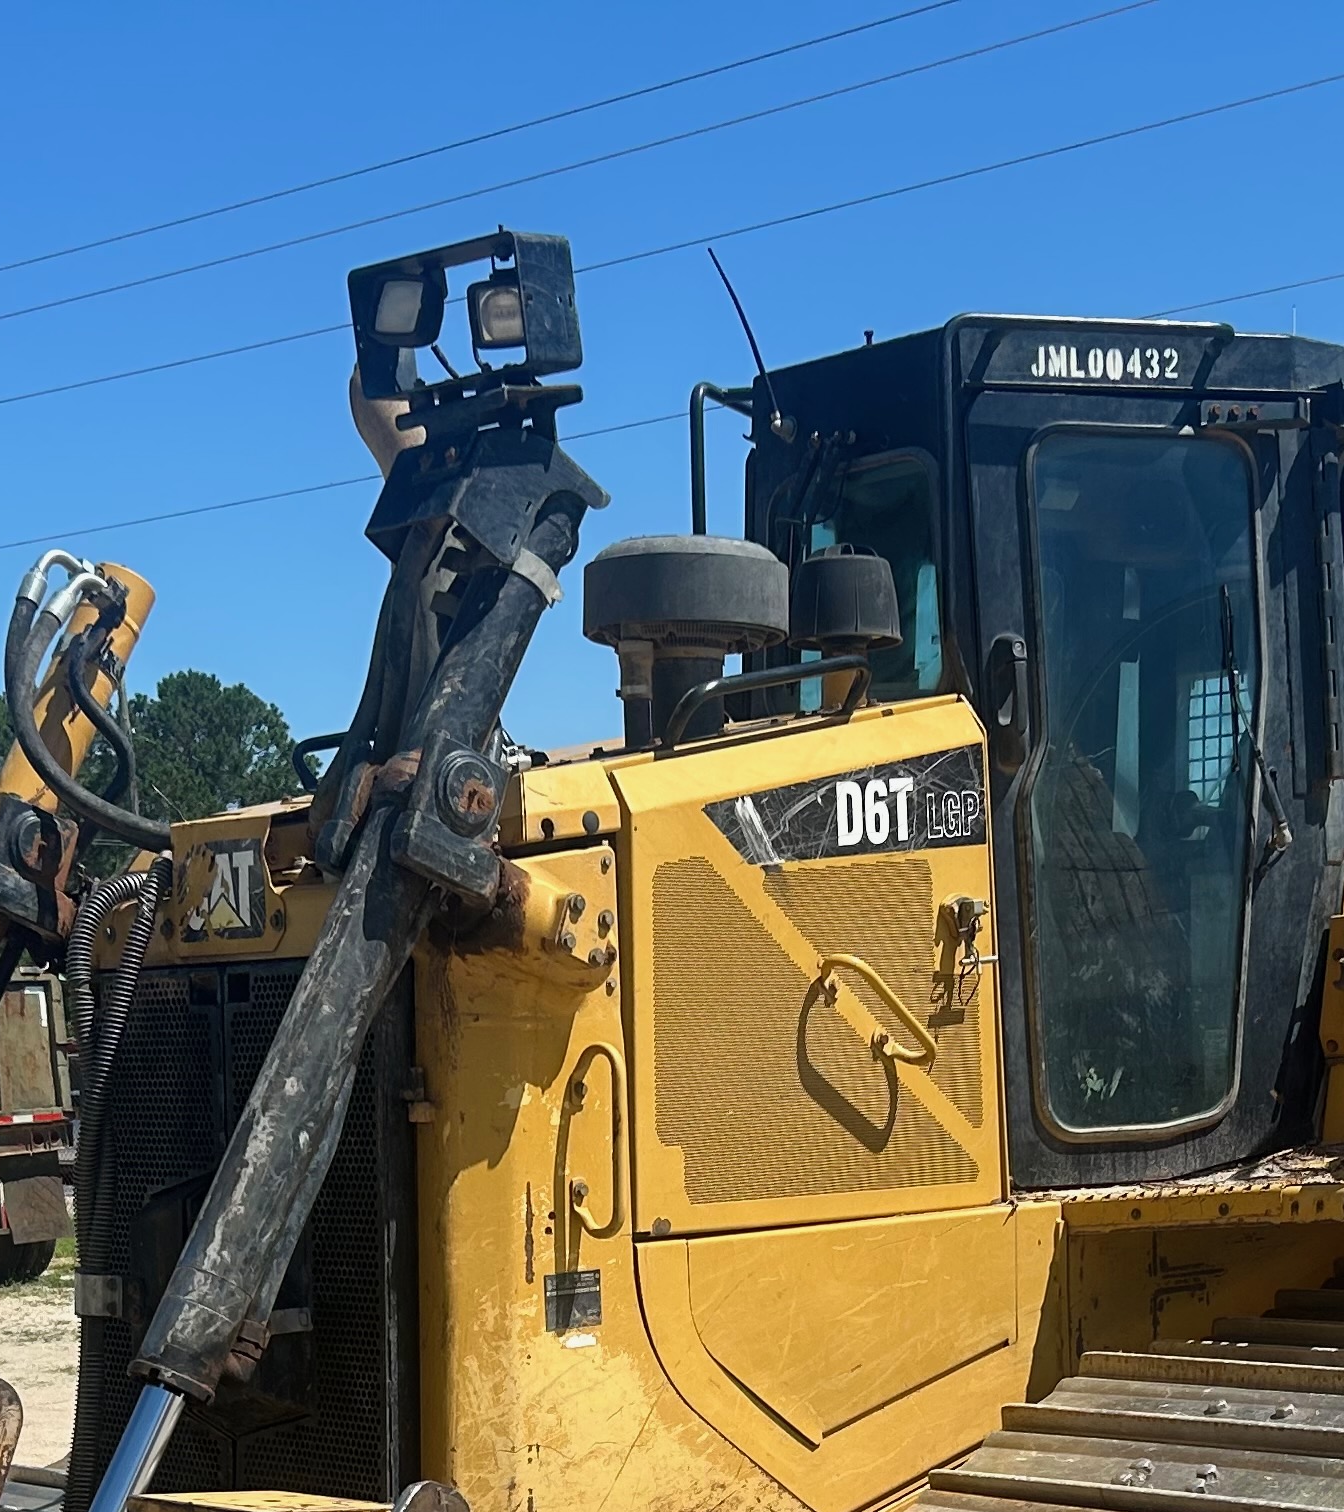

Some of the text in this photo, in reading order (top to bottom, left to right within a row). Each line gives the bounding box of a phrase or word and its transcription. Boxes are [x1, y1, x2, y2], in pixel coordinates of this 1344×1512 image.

[1031, 344, 1179, 381] JML00432
[835, 776, 980, 848] D6T LGP
